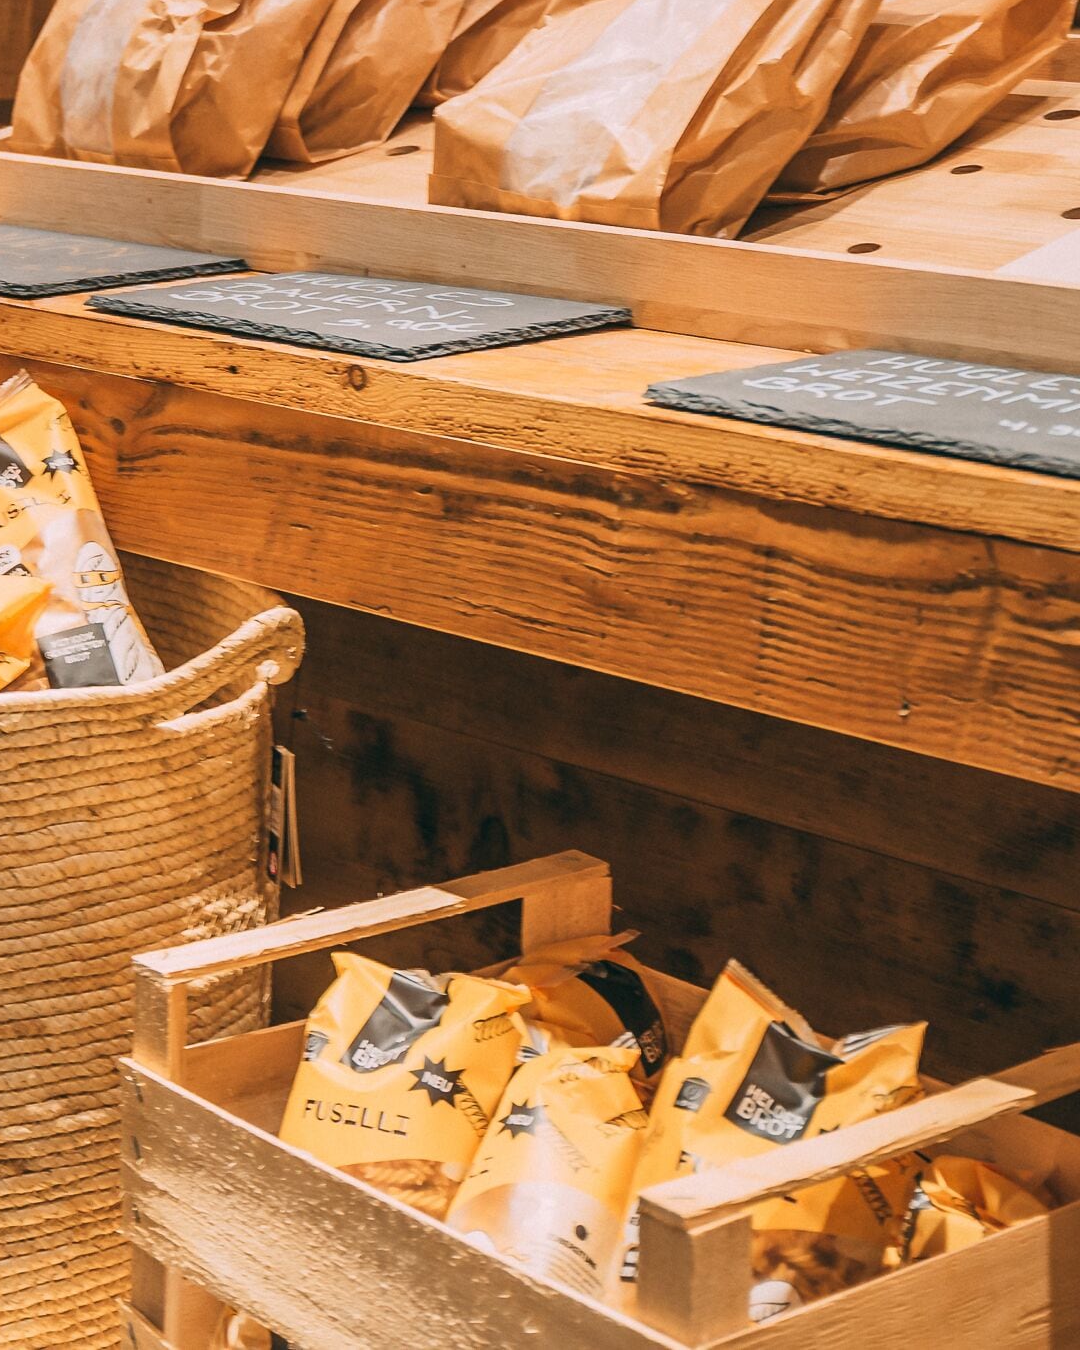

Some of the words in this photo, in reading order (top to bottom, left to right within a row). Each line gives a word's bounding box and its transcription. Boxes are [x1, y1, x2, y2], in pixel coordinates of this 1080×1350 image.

[742, 376, 937, 406] BROT
[866, 355, 1080, 395] HUGLE
[421, 1070, 455, 1094] NEU
[303, 1099, 411, 1137] FUSILLI
[735, 1097, 804, 1139] BROT
